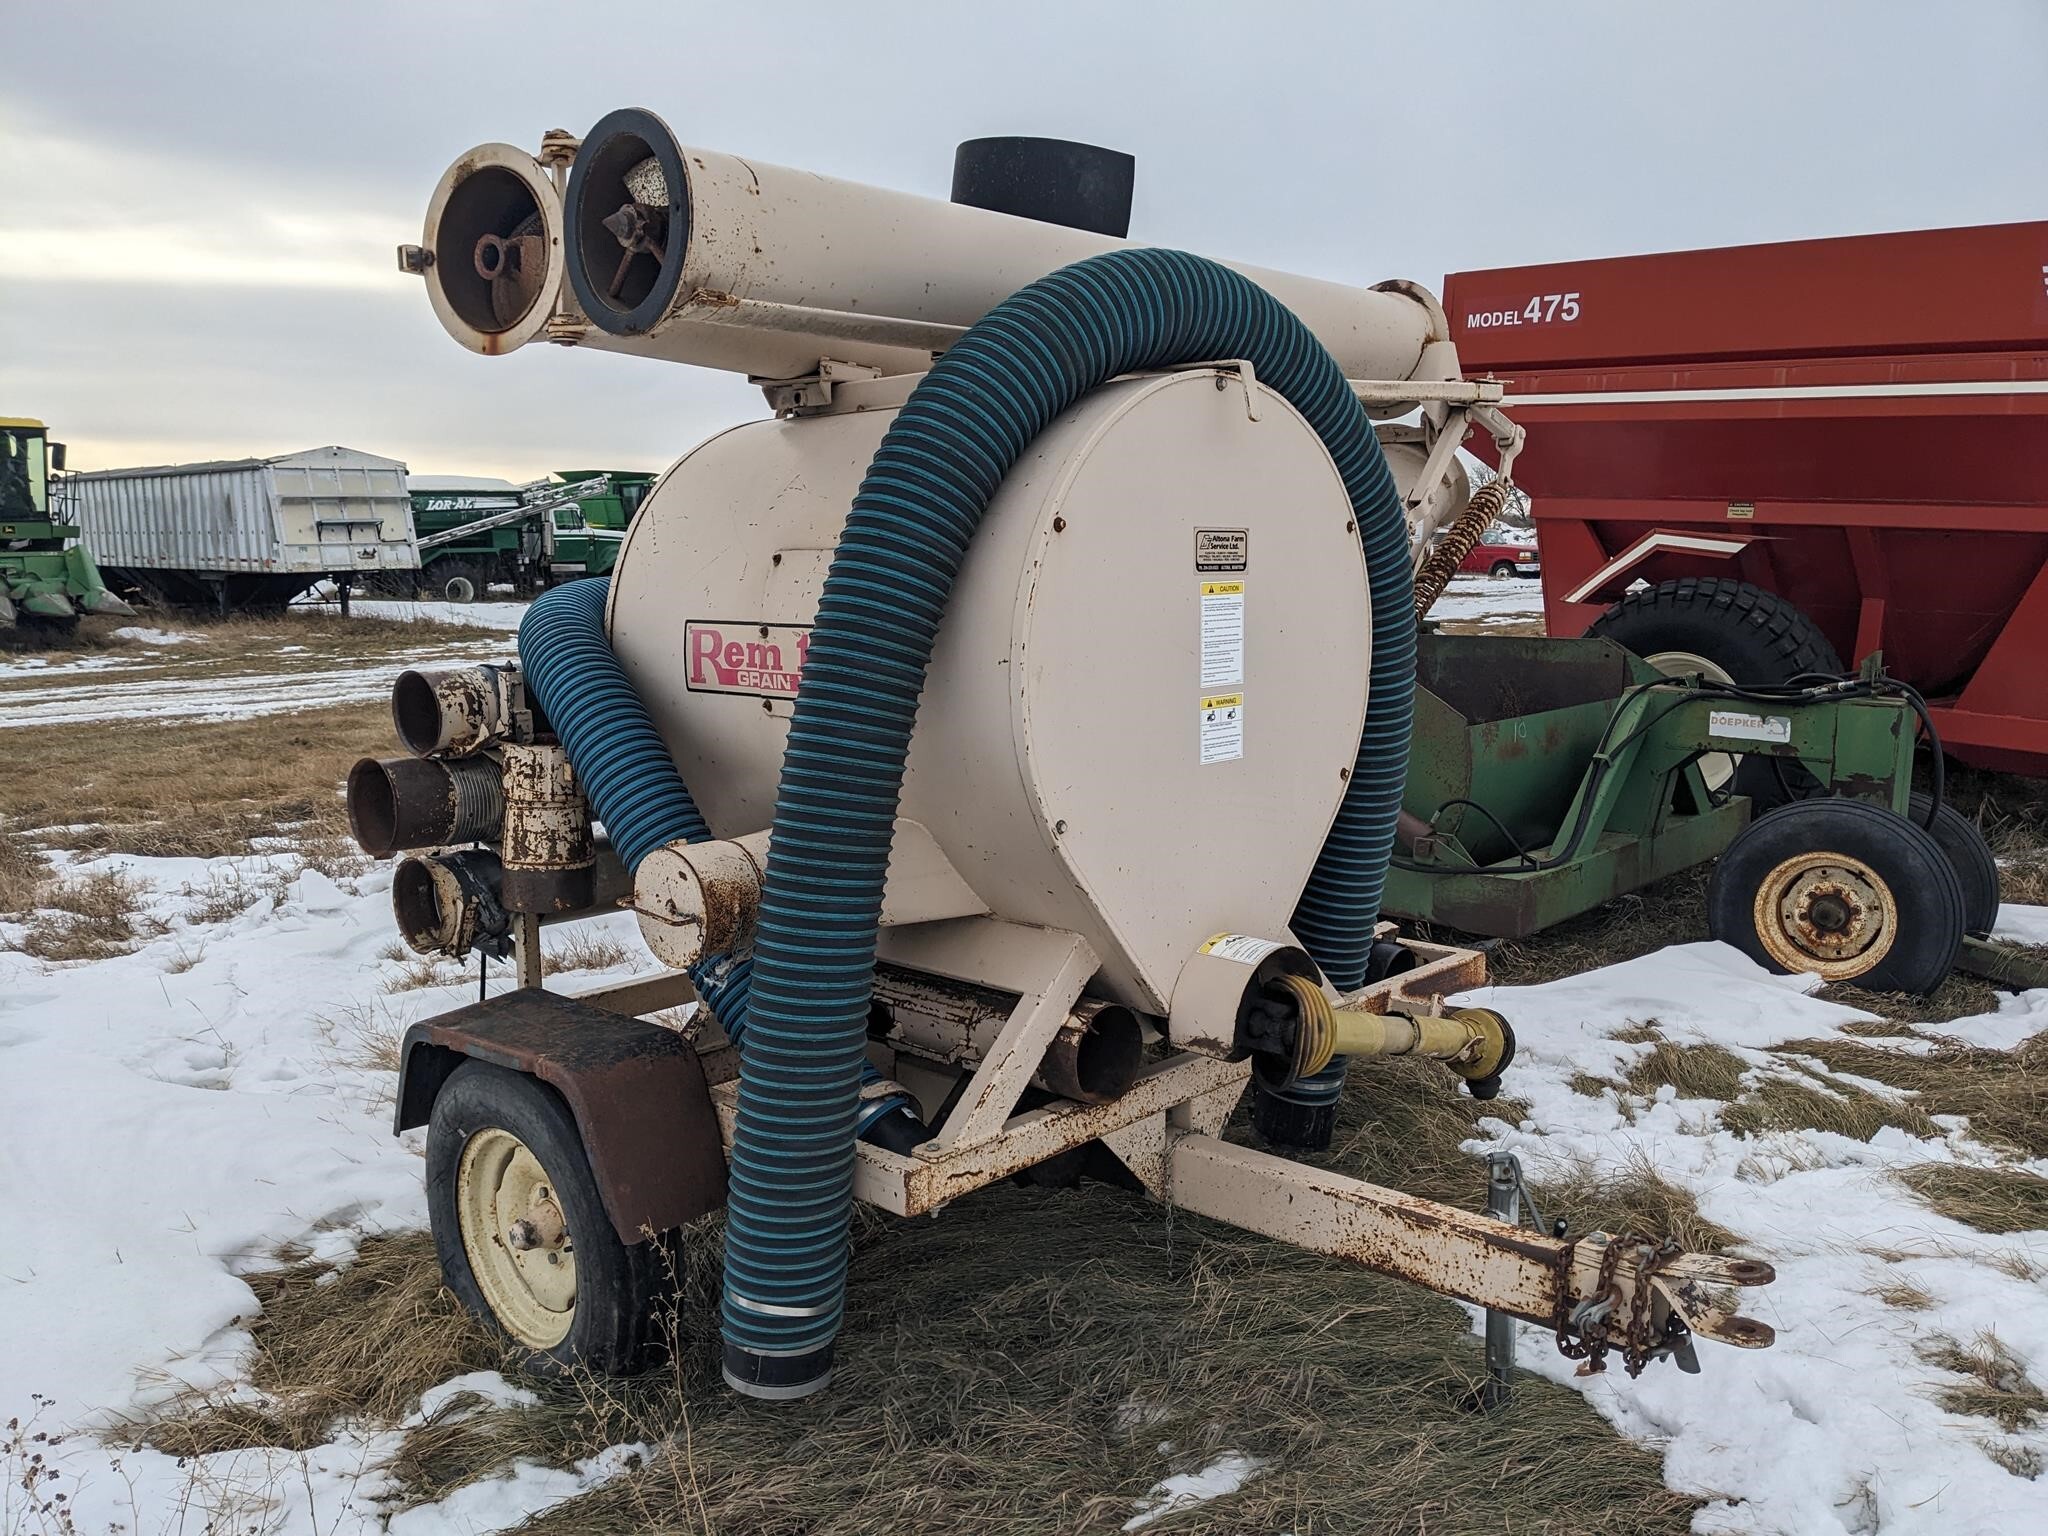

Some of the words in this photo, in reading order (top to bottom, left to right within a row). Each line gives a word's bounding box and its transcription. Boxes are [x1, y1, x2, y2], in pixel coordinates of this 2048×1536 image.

[1467, 311, 1522, 328] MODEL
[1523, 292, 1580, 323] 475
[1210, 542, 1229, 550] Service
[689, 629, 783, 684] Rem
[737, 671, 791, 690] GRAIN
[1215, 697, 1237, 706] WARNING
[1711, 716, 1764, 729] DOEPKER
